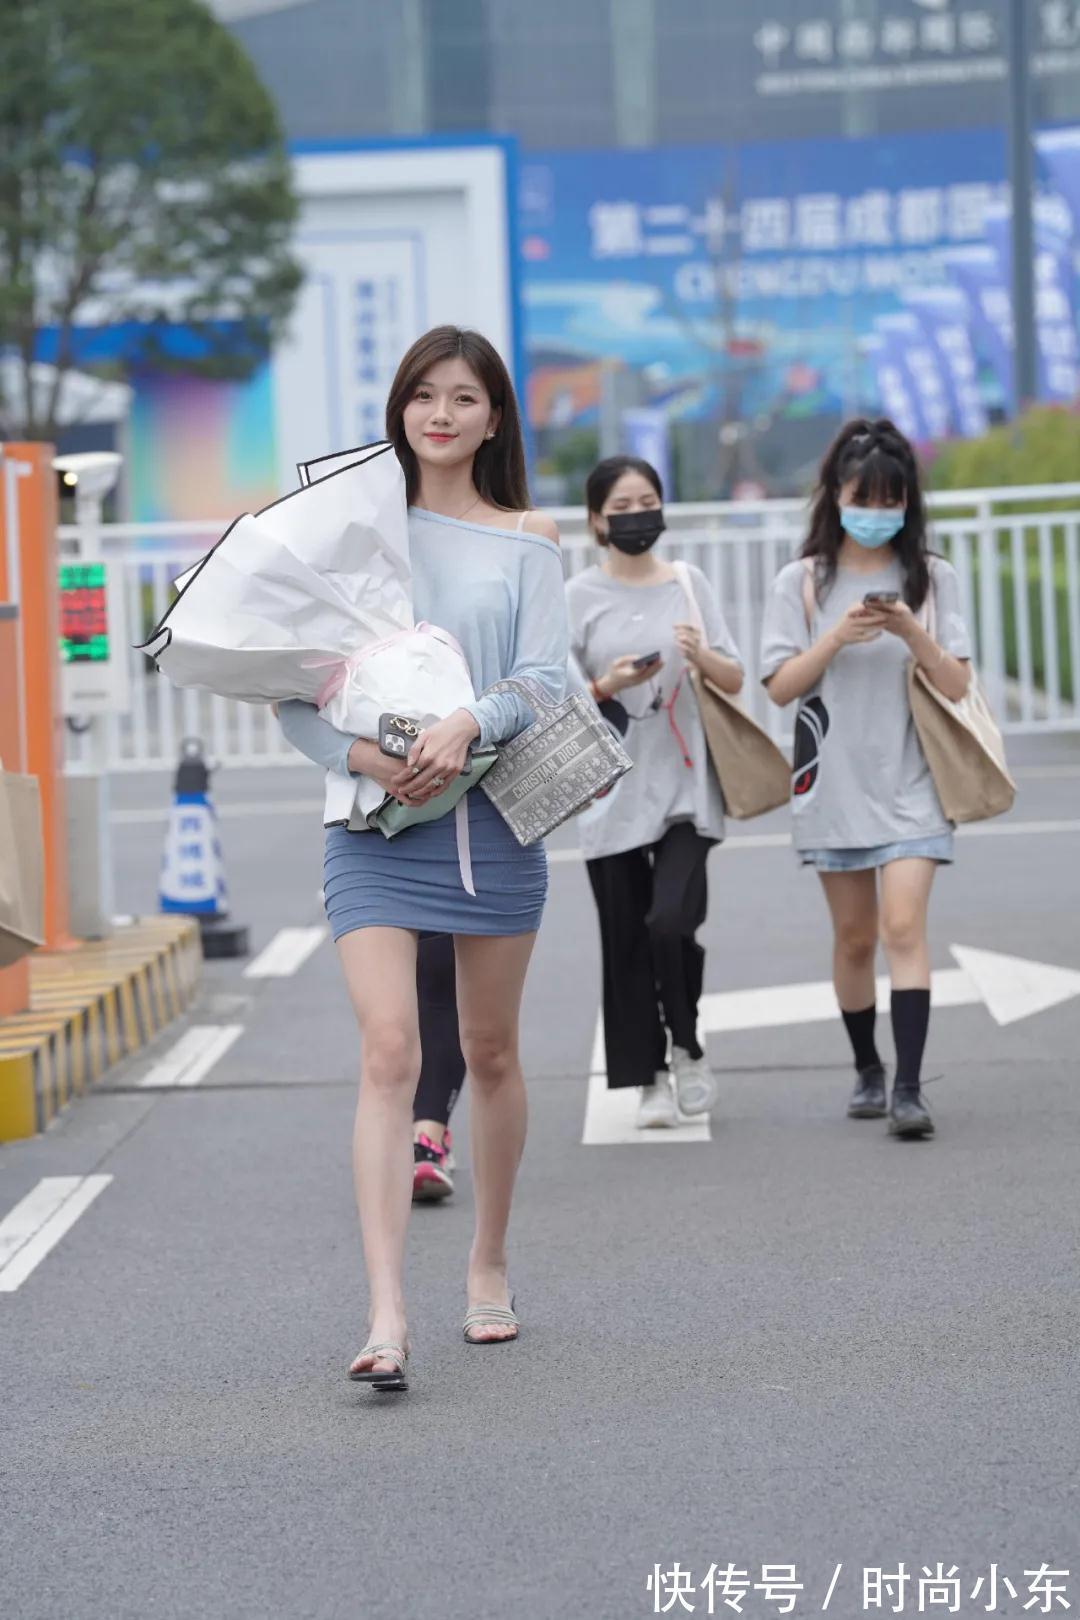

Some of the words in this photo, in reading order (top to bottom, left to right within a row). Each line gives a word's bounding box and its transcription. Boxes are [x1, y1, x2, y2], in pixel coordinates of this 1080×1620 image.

[589, 184, 1010, 258] 第二十四届成都国
[512, 758, 559, 800] CHRISTIAN
[556, 740, 583, 764] DIOR
